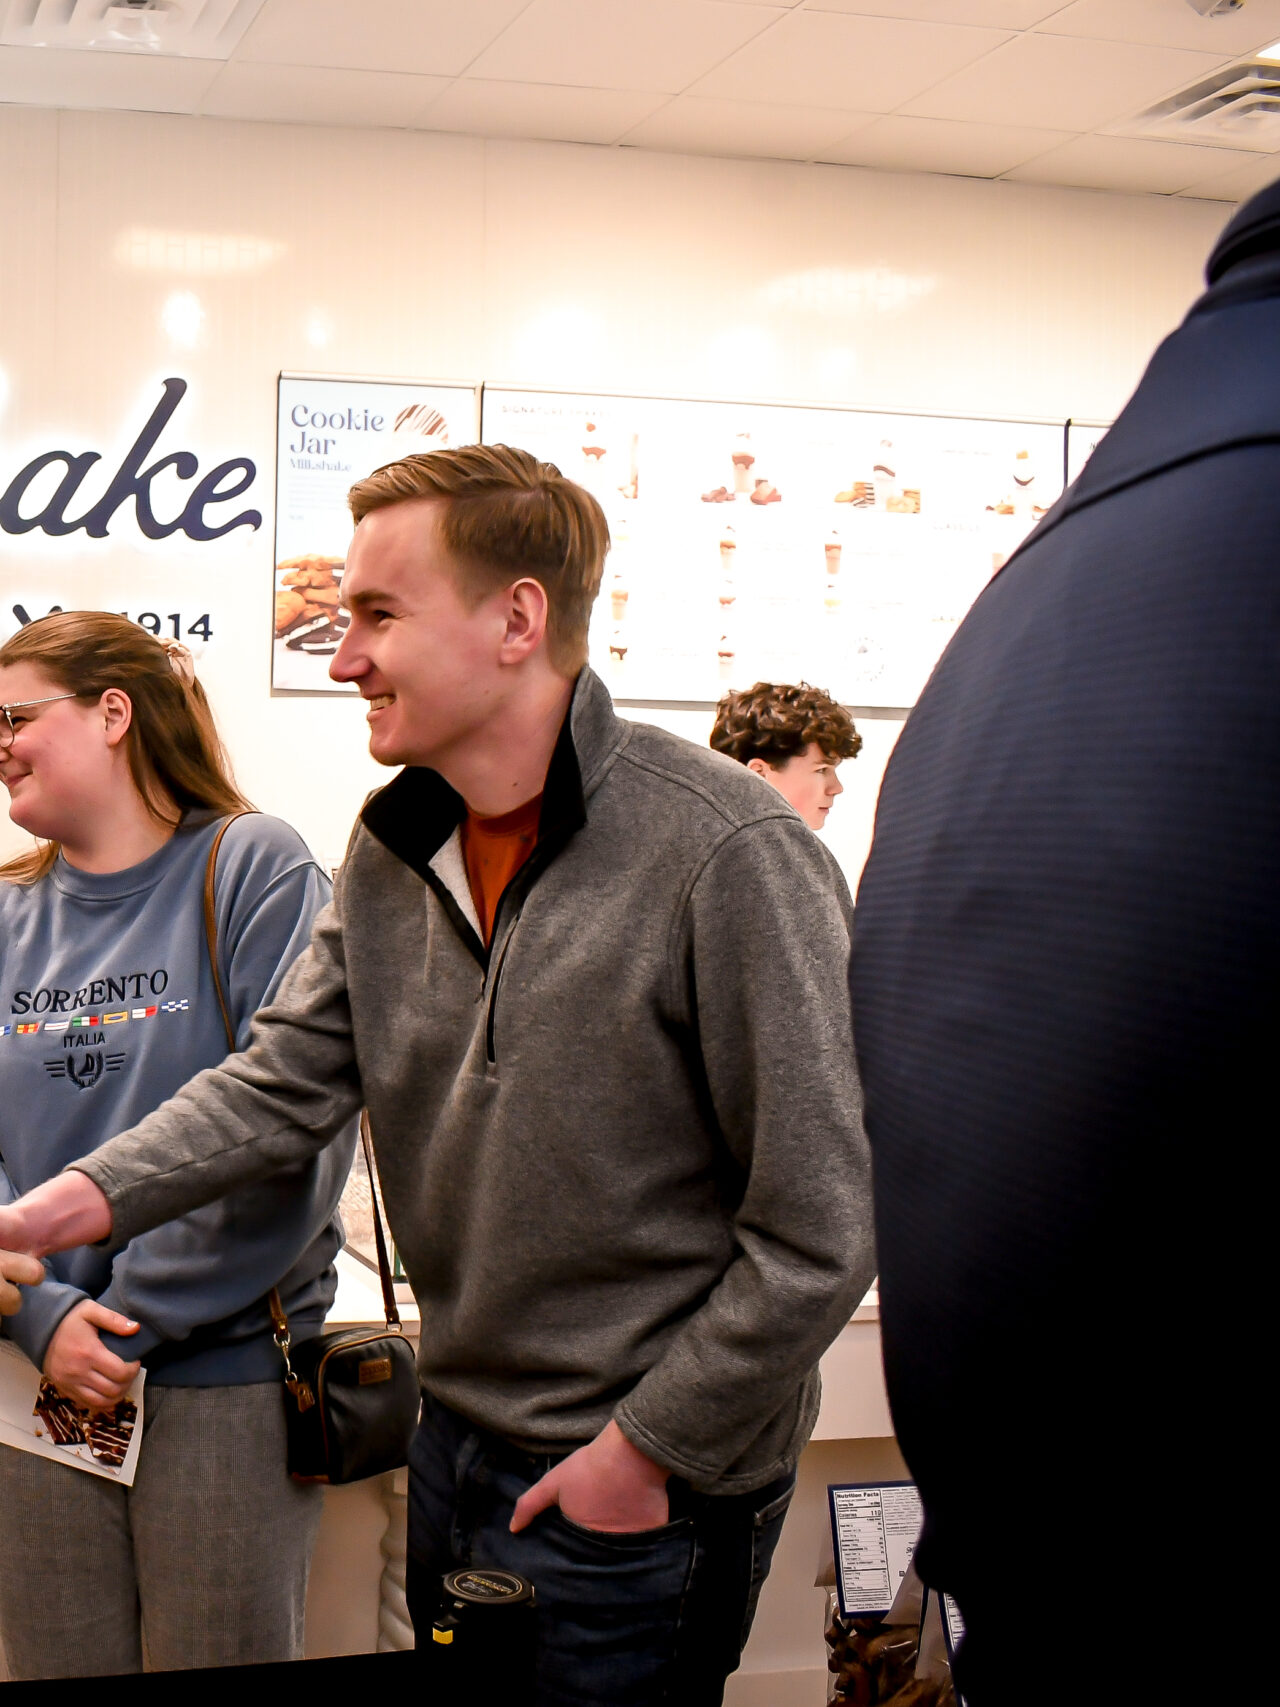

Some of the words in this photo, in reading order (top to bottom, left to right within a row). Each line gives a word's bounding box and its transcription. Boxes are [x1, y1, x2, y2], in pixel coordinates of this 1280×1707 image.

[291, 404, 385, 432] Cookie
[290, 431, 336, 455] Jar
[120, 611, 214, 642] 914
[11, 969, 169, 1015] SORRENTO
[63, 1032, 106, 1048] ITALIA
